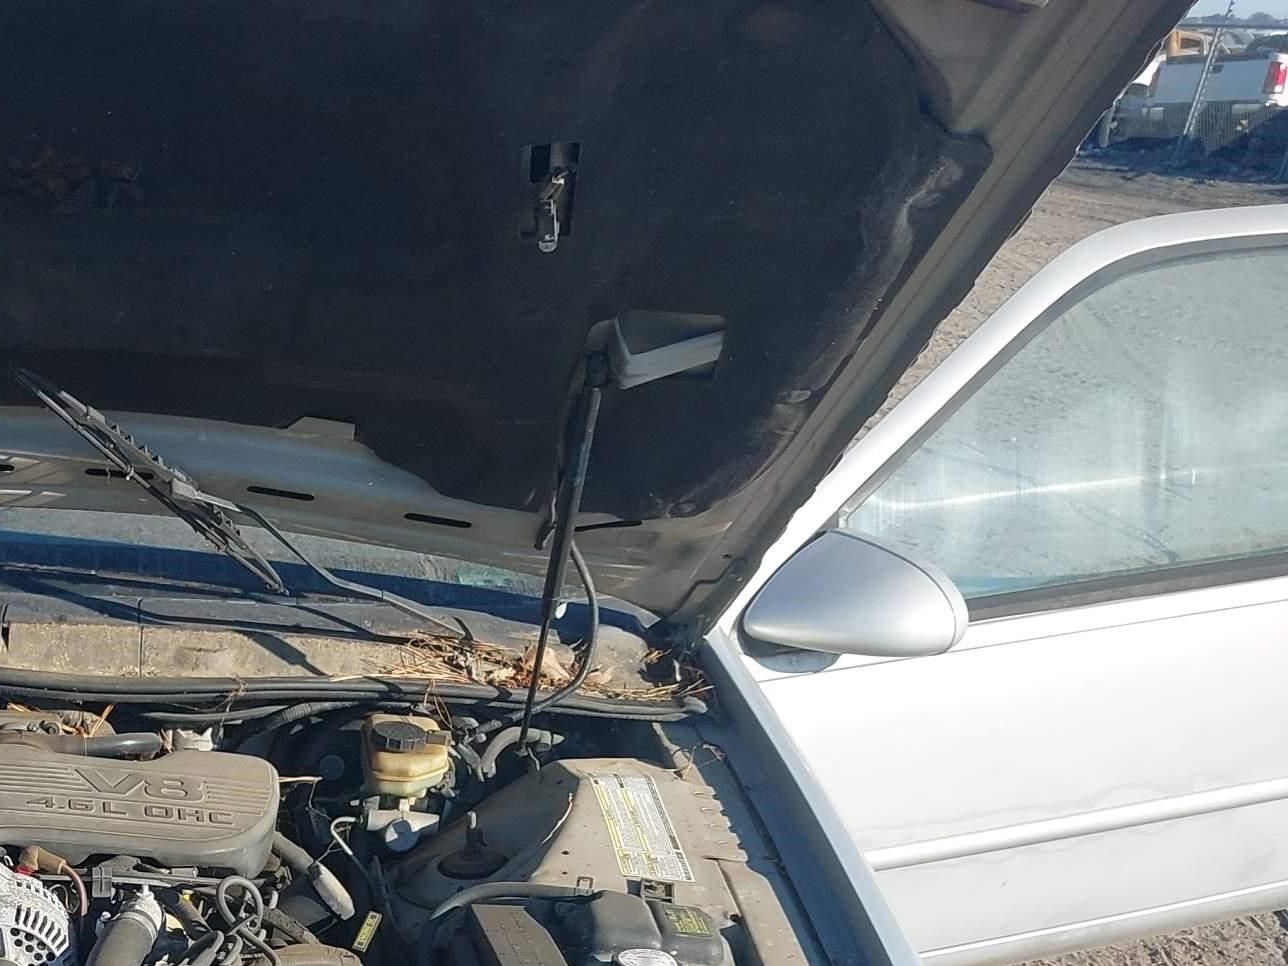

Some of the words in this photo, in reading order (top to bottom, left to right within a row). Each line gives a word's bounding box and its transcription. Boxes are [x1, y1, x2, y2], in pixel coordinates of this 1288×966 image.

[74, 767, 208, 802] V8
[25, 796, 127, 816] 4.6L
[144, 804, 234, 826] OHC
